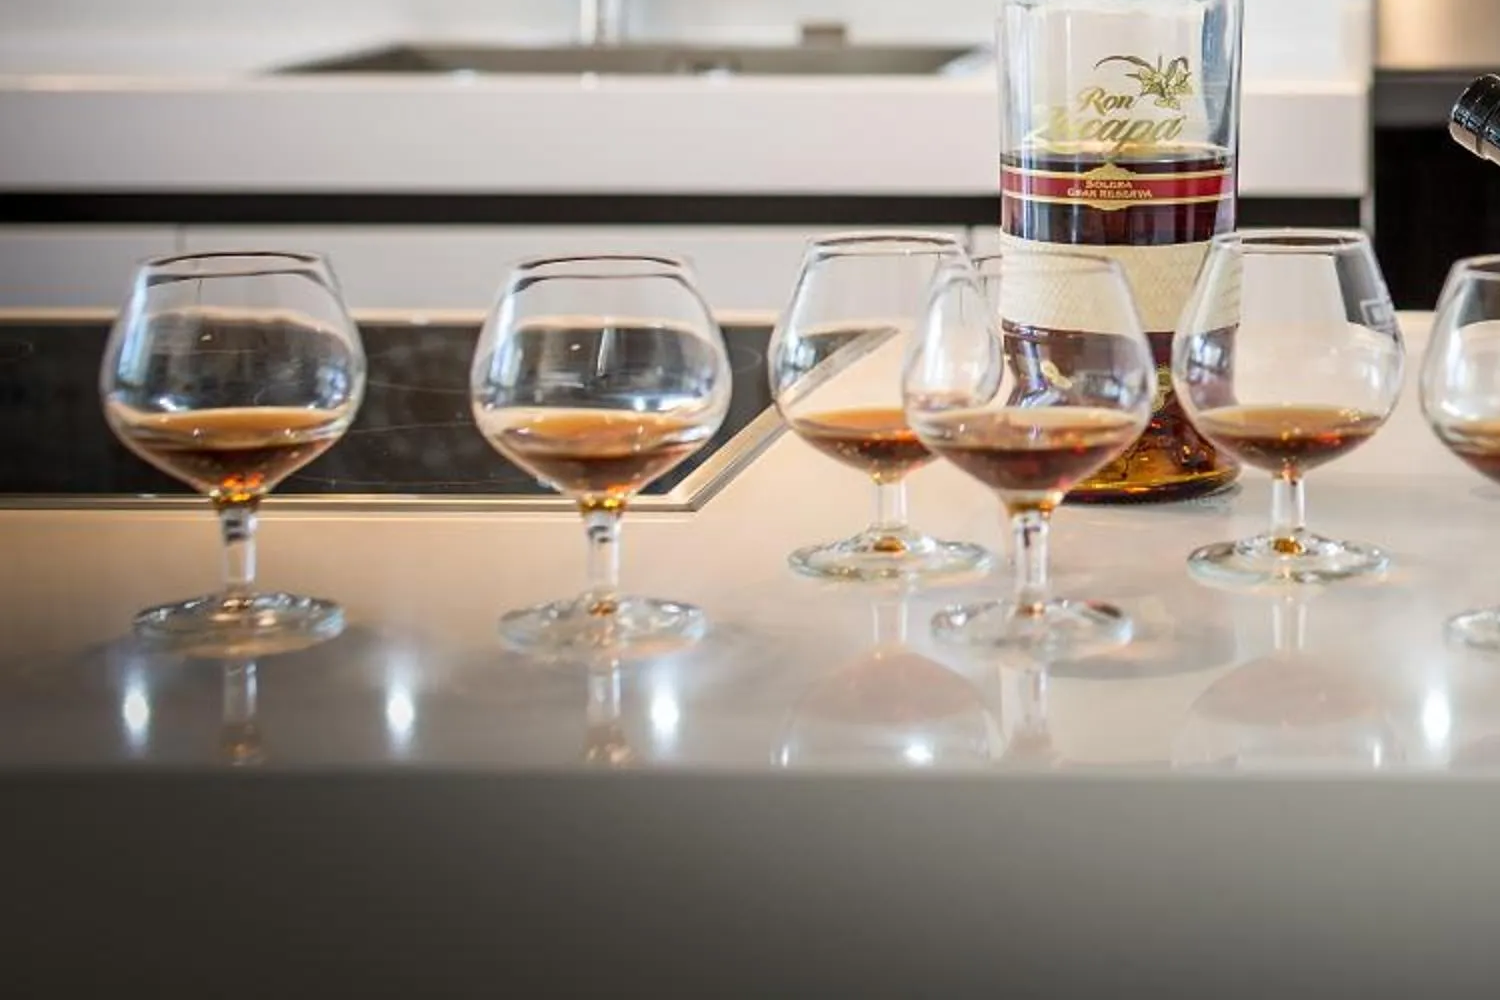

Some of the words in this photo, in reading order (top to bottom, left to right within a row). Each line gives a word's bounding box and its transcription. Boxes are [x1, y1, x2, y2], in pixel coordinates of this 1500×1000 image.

[1076, 85, 1135, 116] Ron
[1085, 179, 1133, 189] SOLERA
[1067, 187, 1097, 198] GRAN
[1099, 188, 1153, 199] RESERVA
